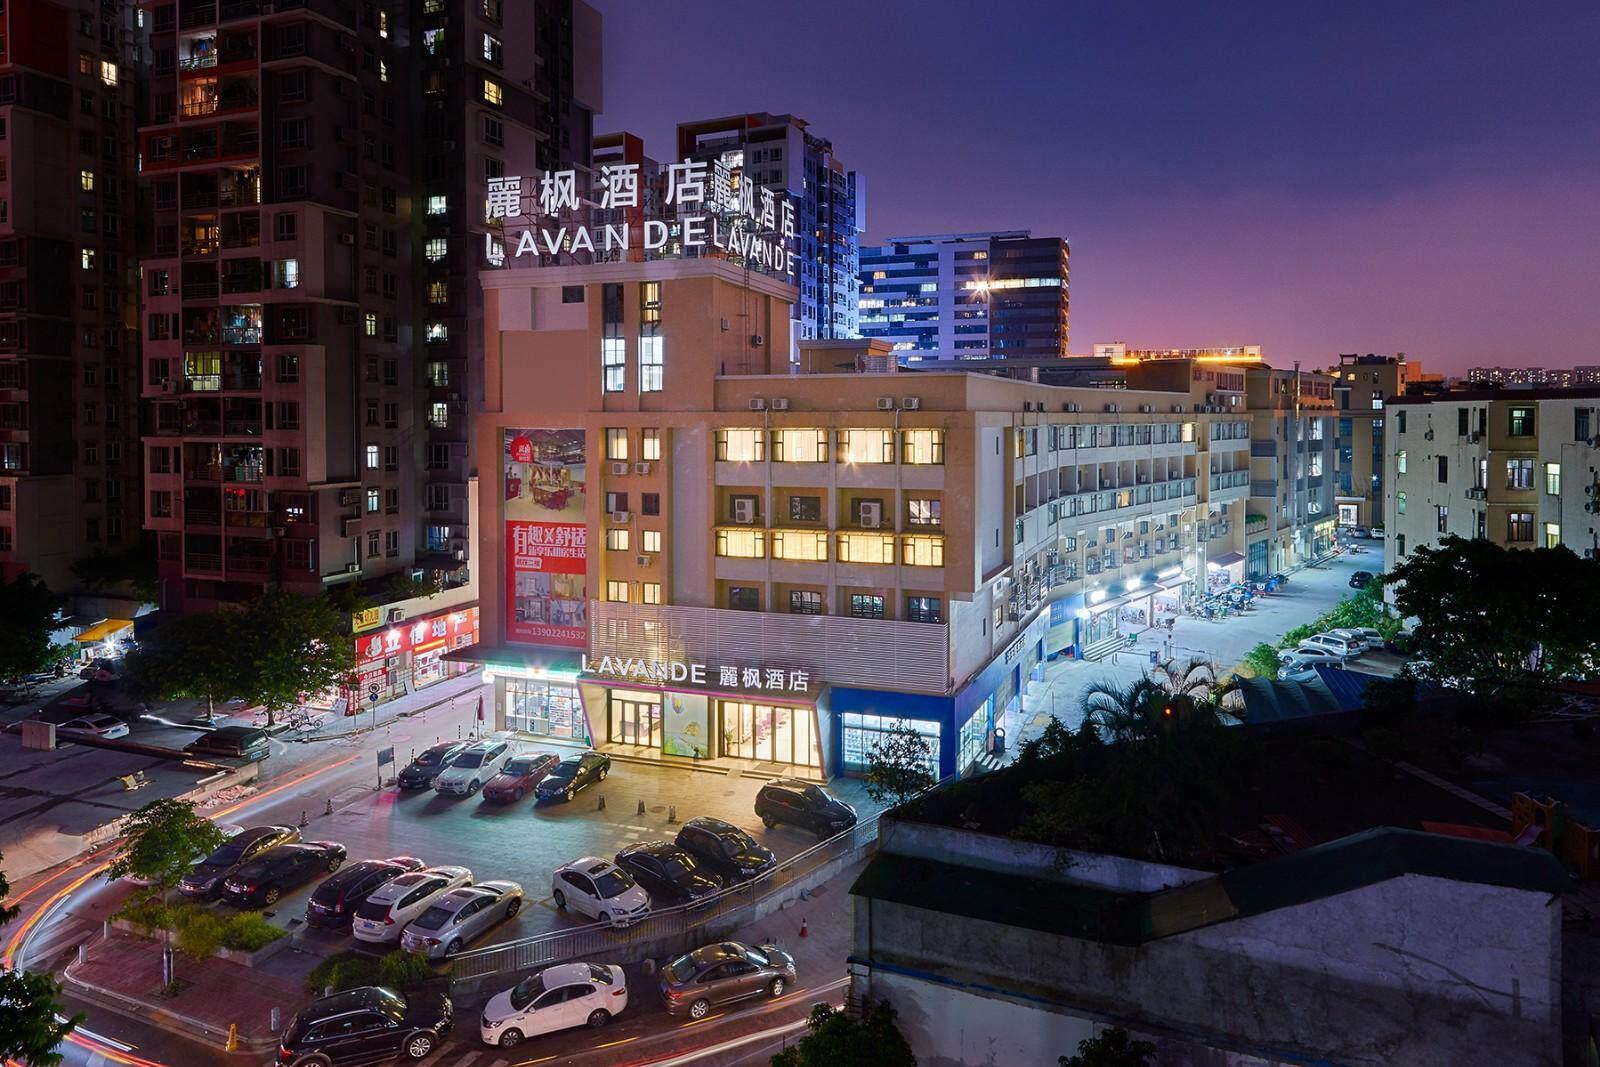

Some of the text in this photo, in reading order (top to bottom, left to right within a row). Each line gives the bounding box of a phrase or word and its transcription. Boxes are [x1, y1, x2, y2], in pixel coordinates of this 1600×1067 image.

[486, 158, 708, 219] 麗枫酒店
[714, 159, 795, 240] 麗枫酒店
[486, 216, 706, 260] LAVANDE
[713, 217, 795, 276] LAVANDE
[581, 653, 809, 692] LAVANDE 麗枫酒店
